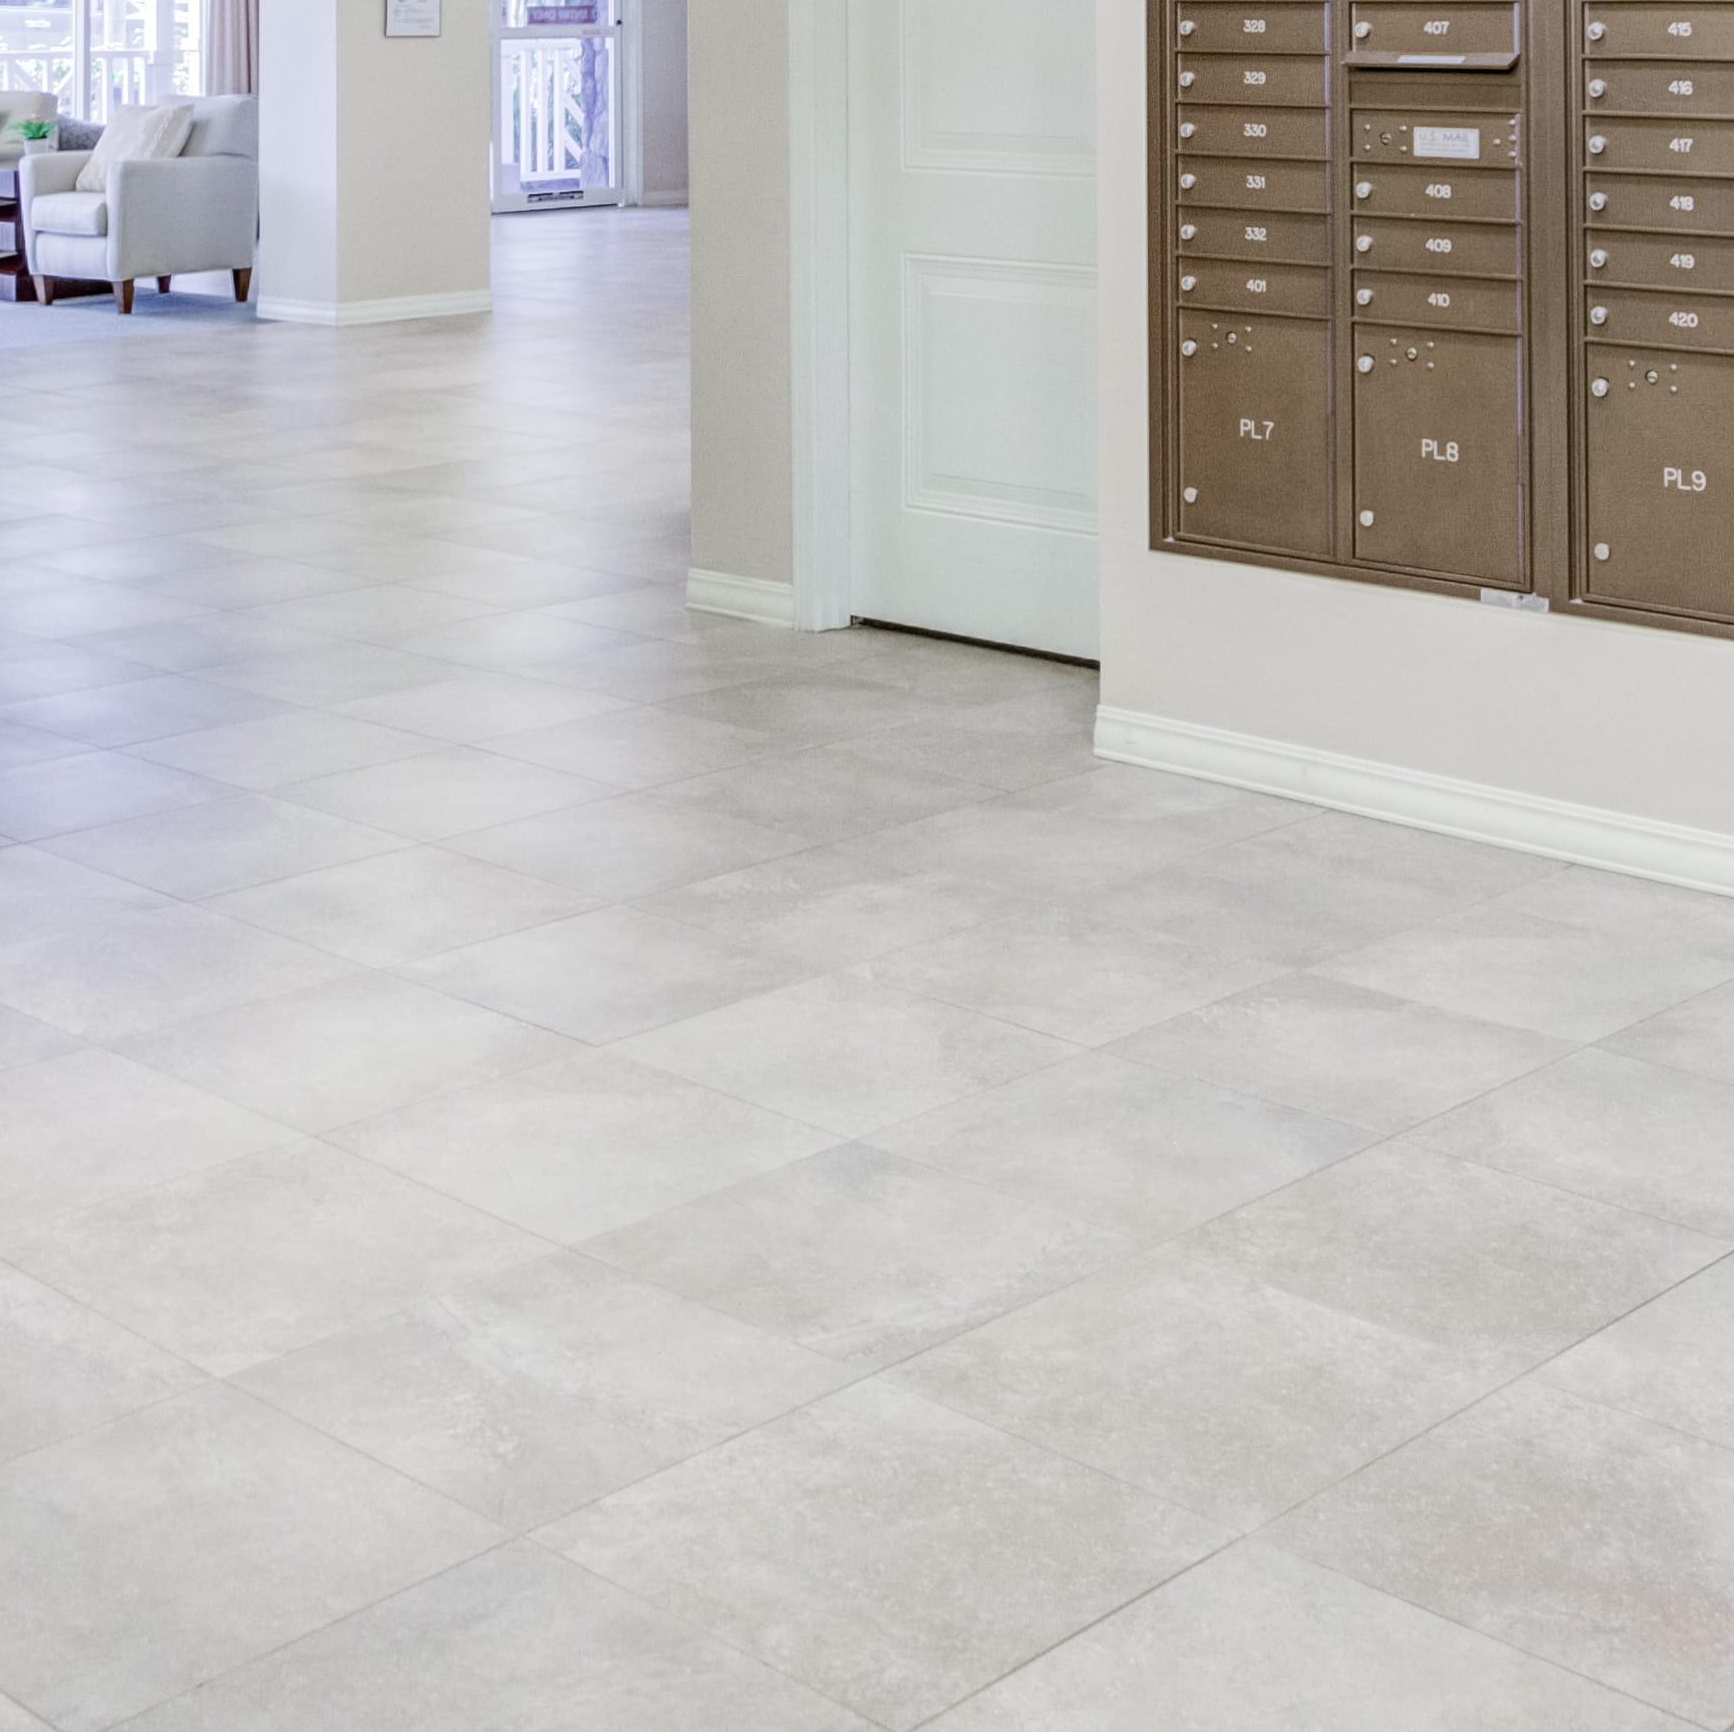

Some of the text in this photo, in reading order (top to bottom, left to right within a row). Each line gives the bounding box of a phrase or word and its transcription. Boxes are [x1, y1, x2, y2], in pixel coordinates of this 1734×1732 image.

[1243, 19, 1266, 33] 328
[1423, 20, 1450, 35] 407
[1243, 70, 1267, 85] 329
[1243, 123, 1267, 138] 330
[1669, 138, 1694, 153] 417
[1245, 175, 1266, 190] 331
[1425, 183, 1452, 199] 408
[1244, 226, 1267, 242] 332
[1425, 238, 1452, 253] 409
[1669, 253, 1695, 269] 419
[1246, 278, 1267, 293] 401
[1427, 292, 1451, 308] 410
[1668, 311, 1699, 328] 420
[1239, 418, 1275, 440] PL7
[1421, 438, 1459, 462] PL8
[1663, 466, 1707, 492] PL9
